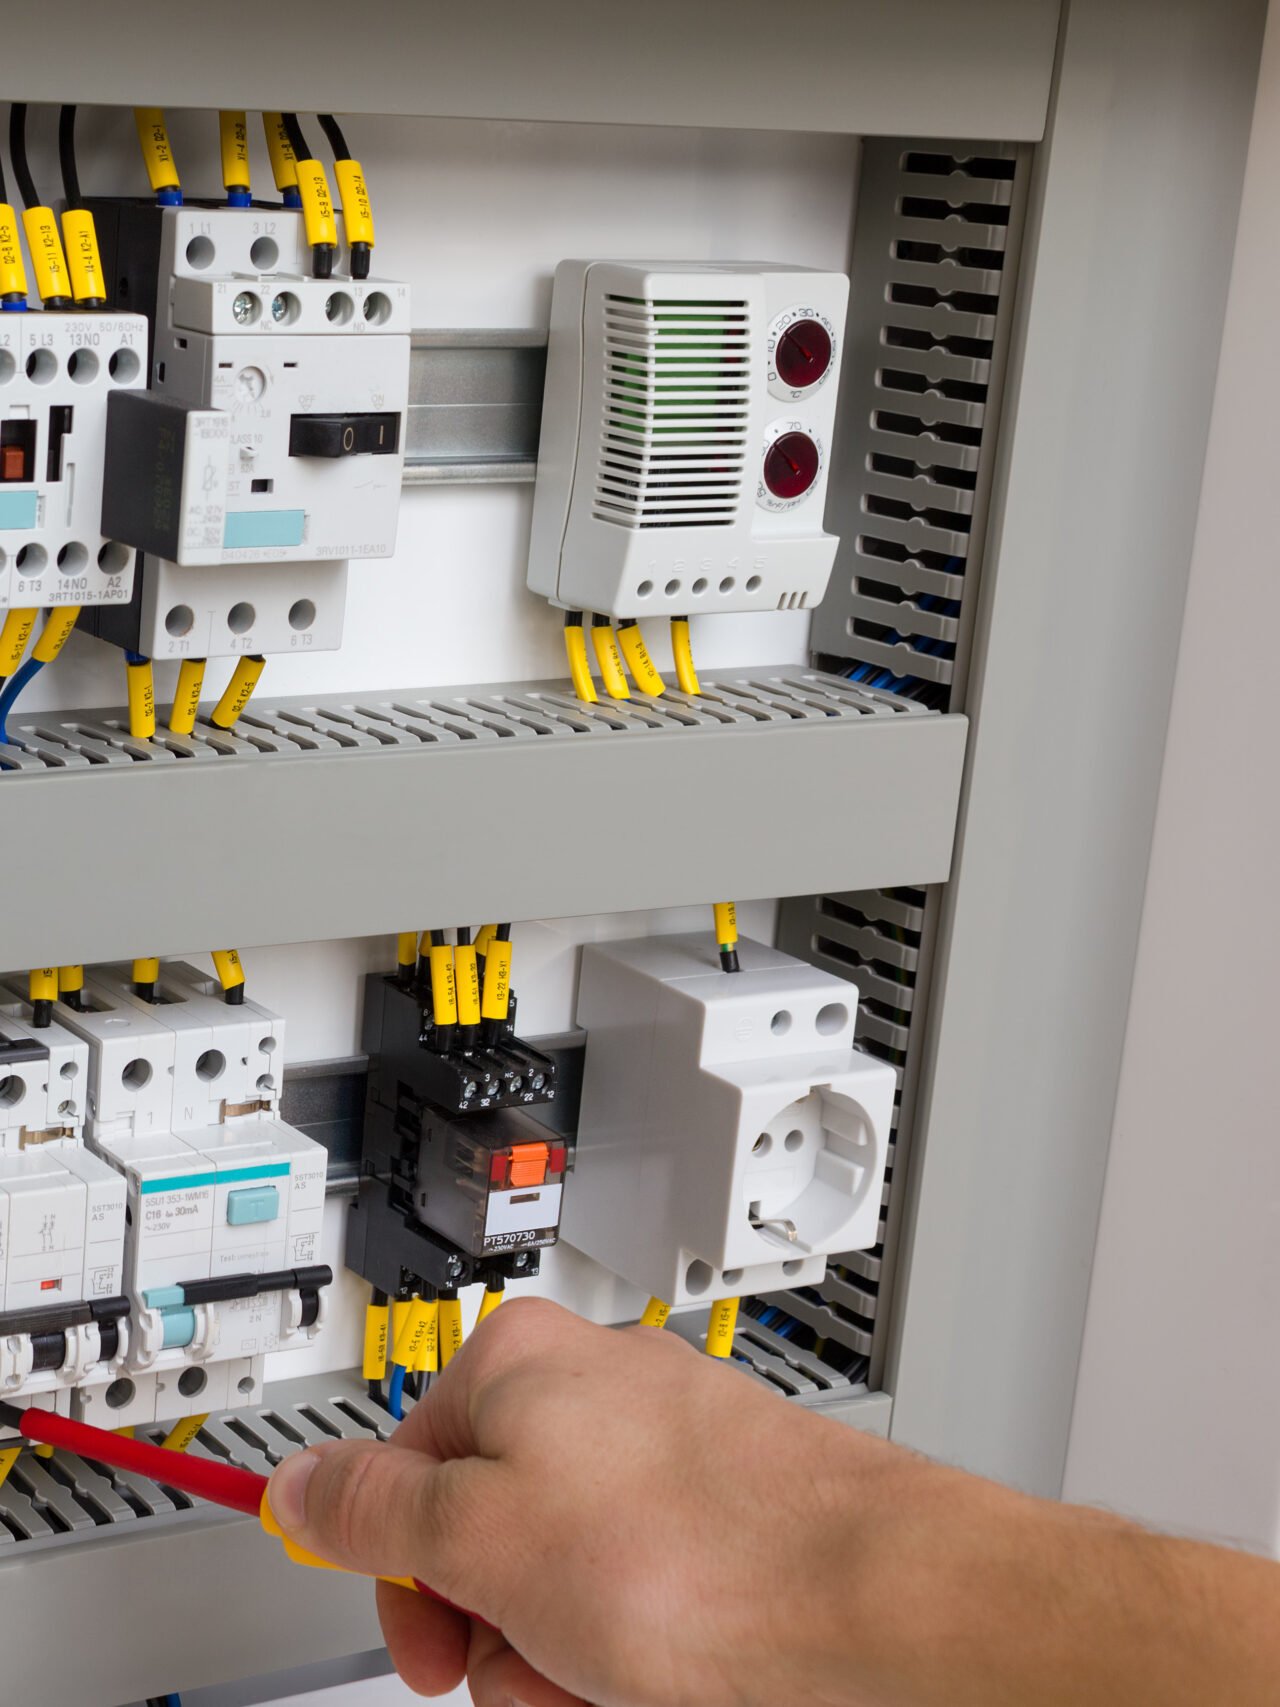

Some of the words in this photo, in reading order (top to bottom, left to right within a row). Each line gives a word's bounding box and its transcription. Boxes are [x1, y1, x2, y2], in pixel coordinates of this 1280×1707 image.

[63, 322, 92, 334] 230V
[29, 333, 37, 346] 5
[41, 333, 54, 346] L3
[119, 332, 134, 346] A1
[29, 577, 42, 591] T3
[184, 1107, 193, 1120] N
[483, 1231, 536, 1247] PT570730
